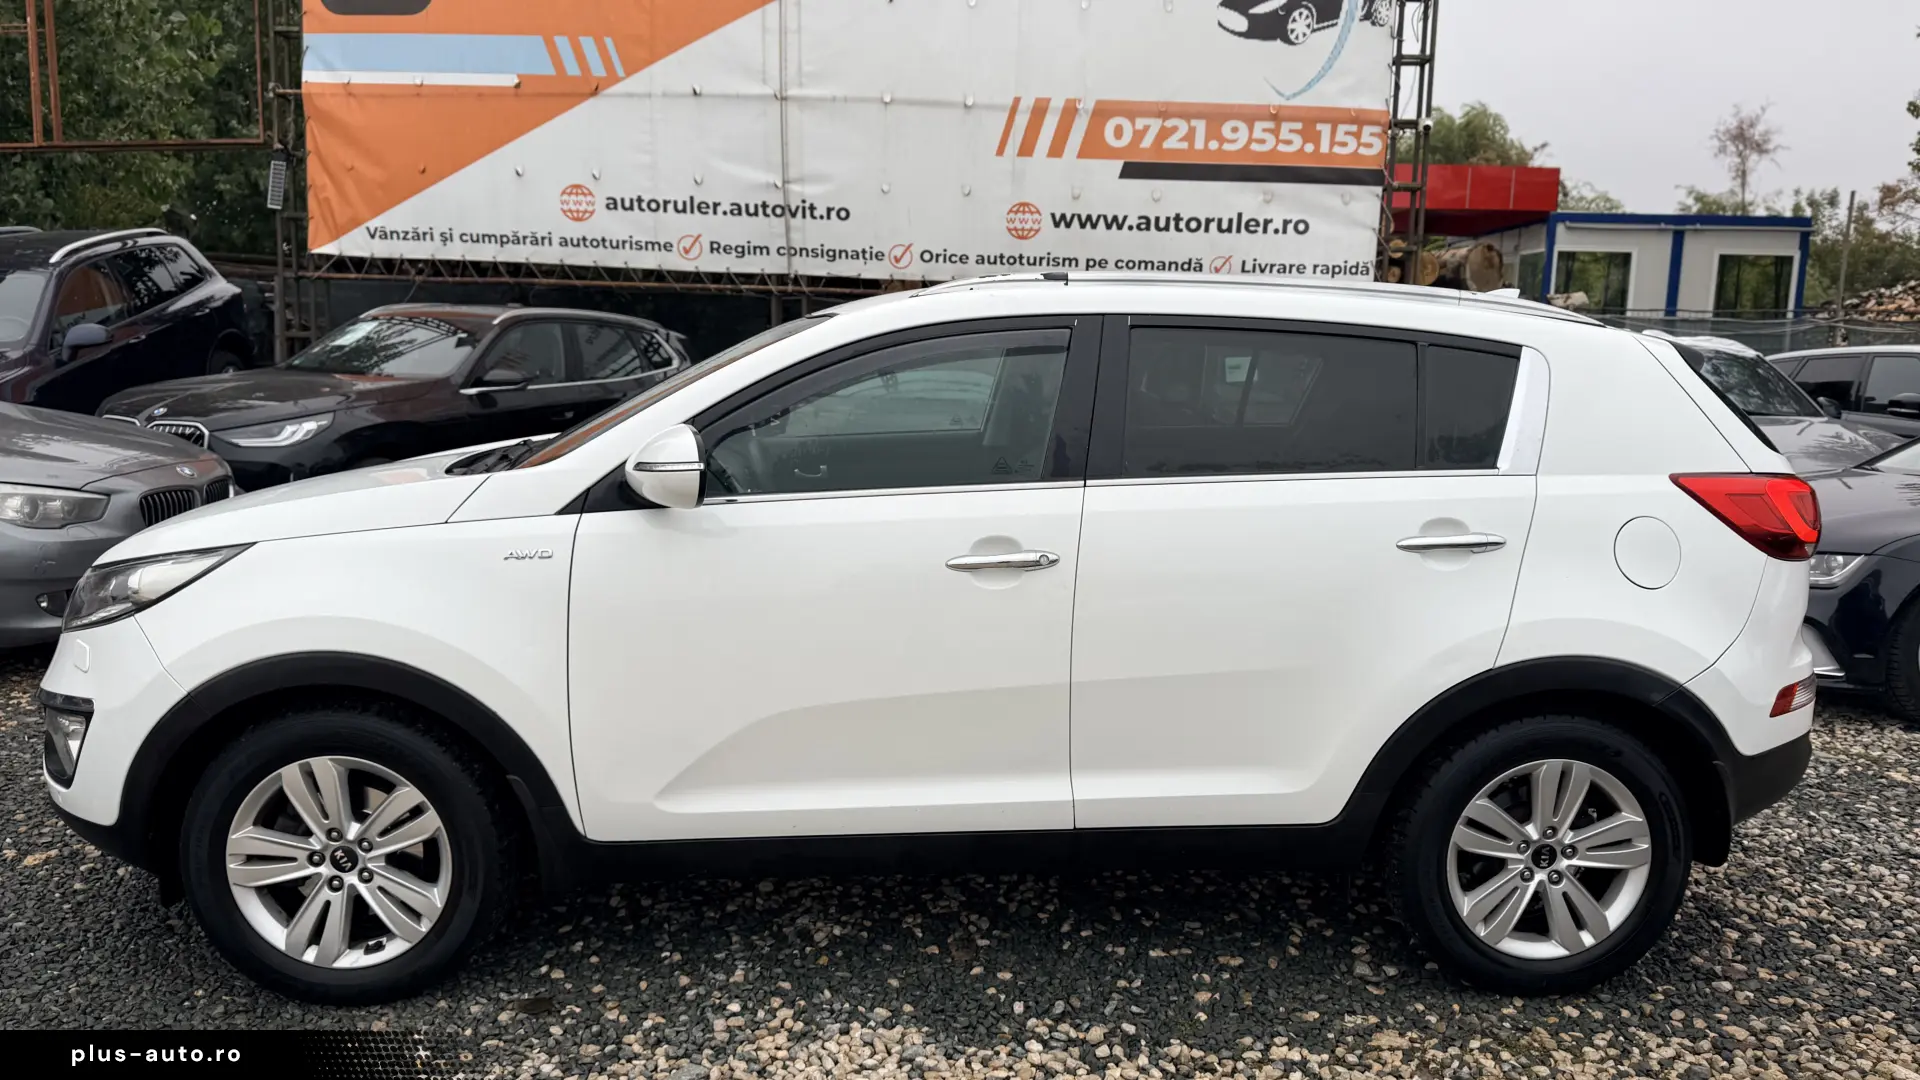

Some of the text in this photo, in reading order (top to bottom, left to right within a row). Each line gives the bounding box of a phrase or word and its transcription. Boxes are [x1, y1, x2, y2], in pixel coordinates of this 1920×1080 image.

[1104, 116, 1383, 156] 0721.955.155
[605, 195, 850, 221] autoruler.autovit.ro
[1050, 212, 1310, 235] www.autoruler.ro
[366, 226, 434, 242] Vânzări
[459, 230, 553, 248] cumpărări
[558, 235, 674, 252] autoturisme
[709, 240, 771, 258] Regim
[919, 249, 1204, 273] Orice autoturism pe comandă
[1241, 258, 1371, 278] Livrare rapidă
[503, 548, 554, 561] AWD
